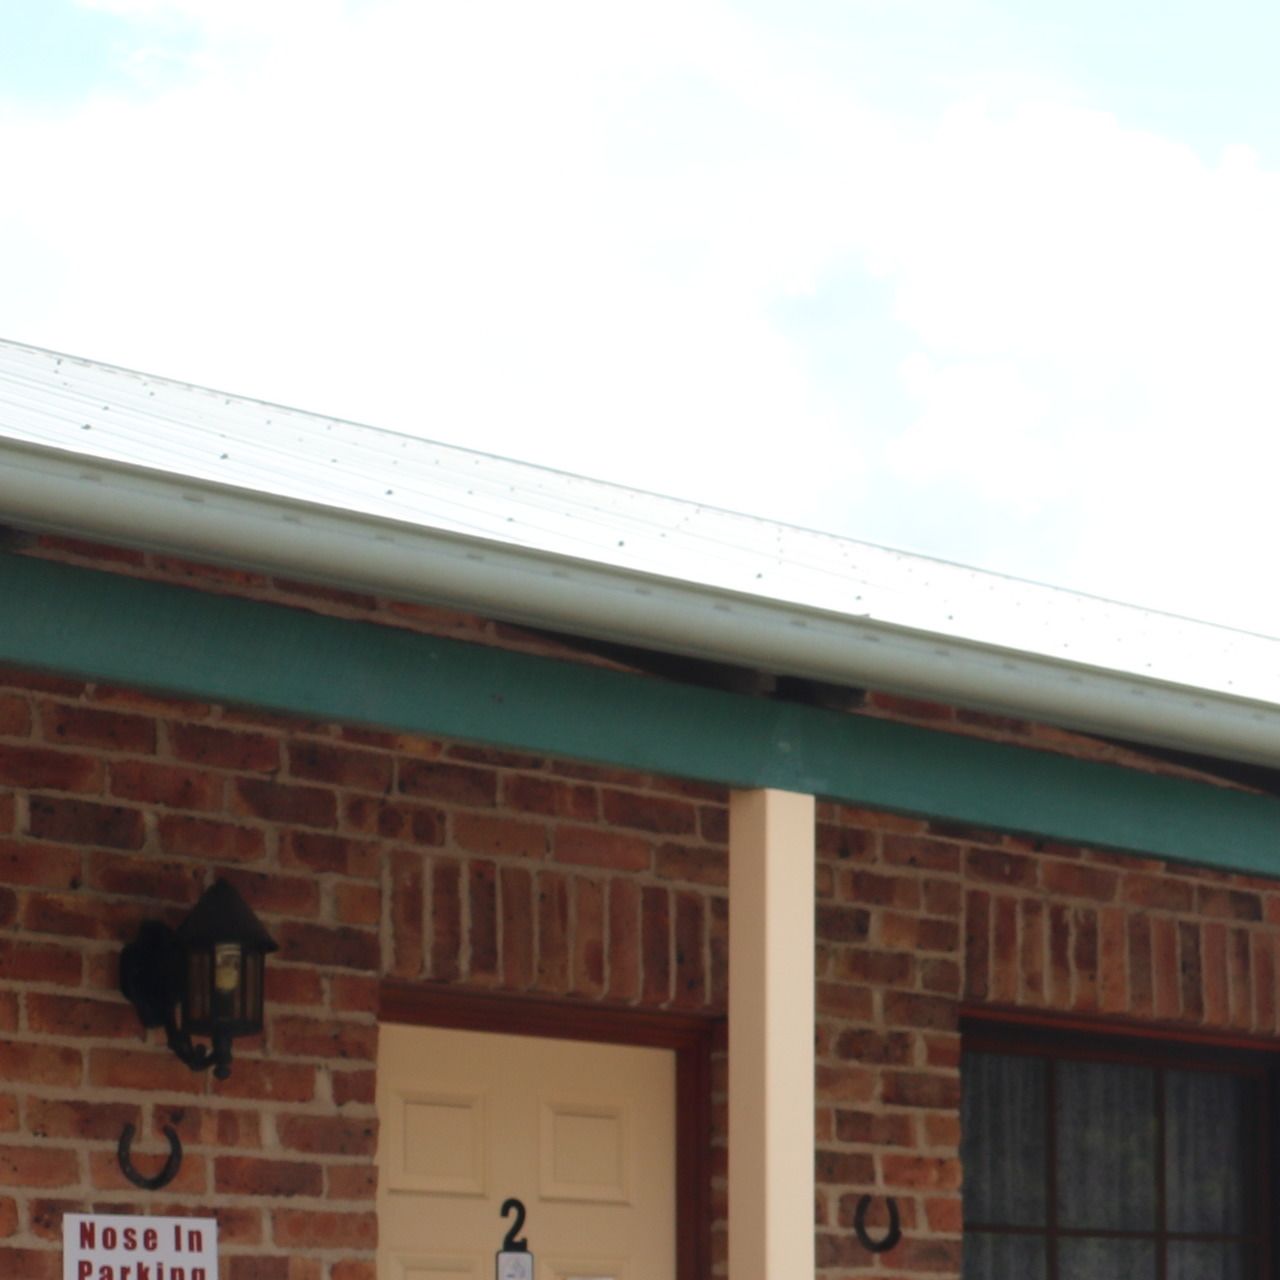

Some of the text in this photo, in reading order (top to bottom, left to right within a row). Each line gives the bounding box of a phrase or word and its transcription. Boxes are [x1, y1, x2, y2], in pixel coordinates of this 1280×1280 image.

[80, 1221, 203, 1252] Nose In
[500, 1198, 527, 1251] 2
